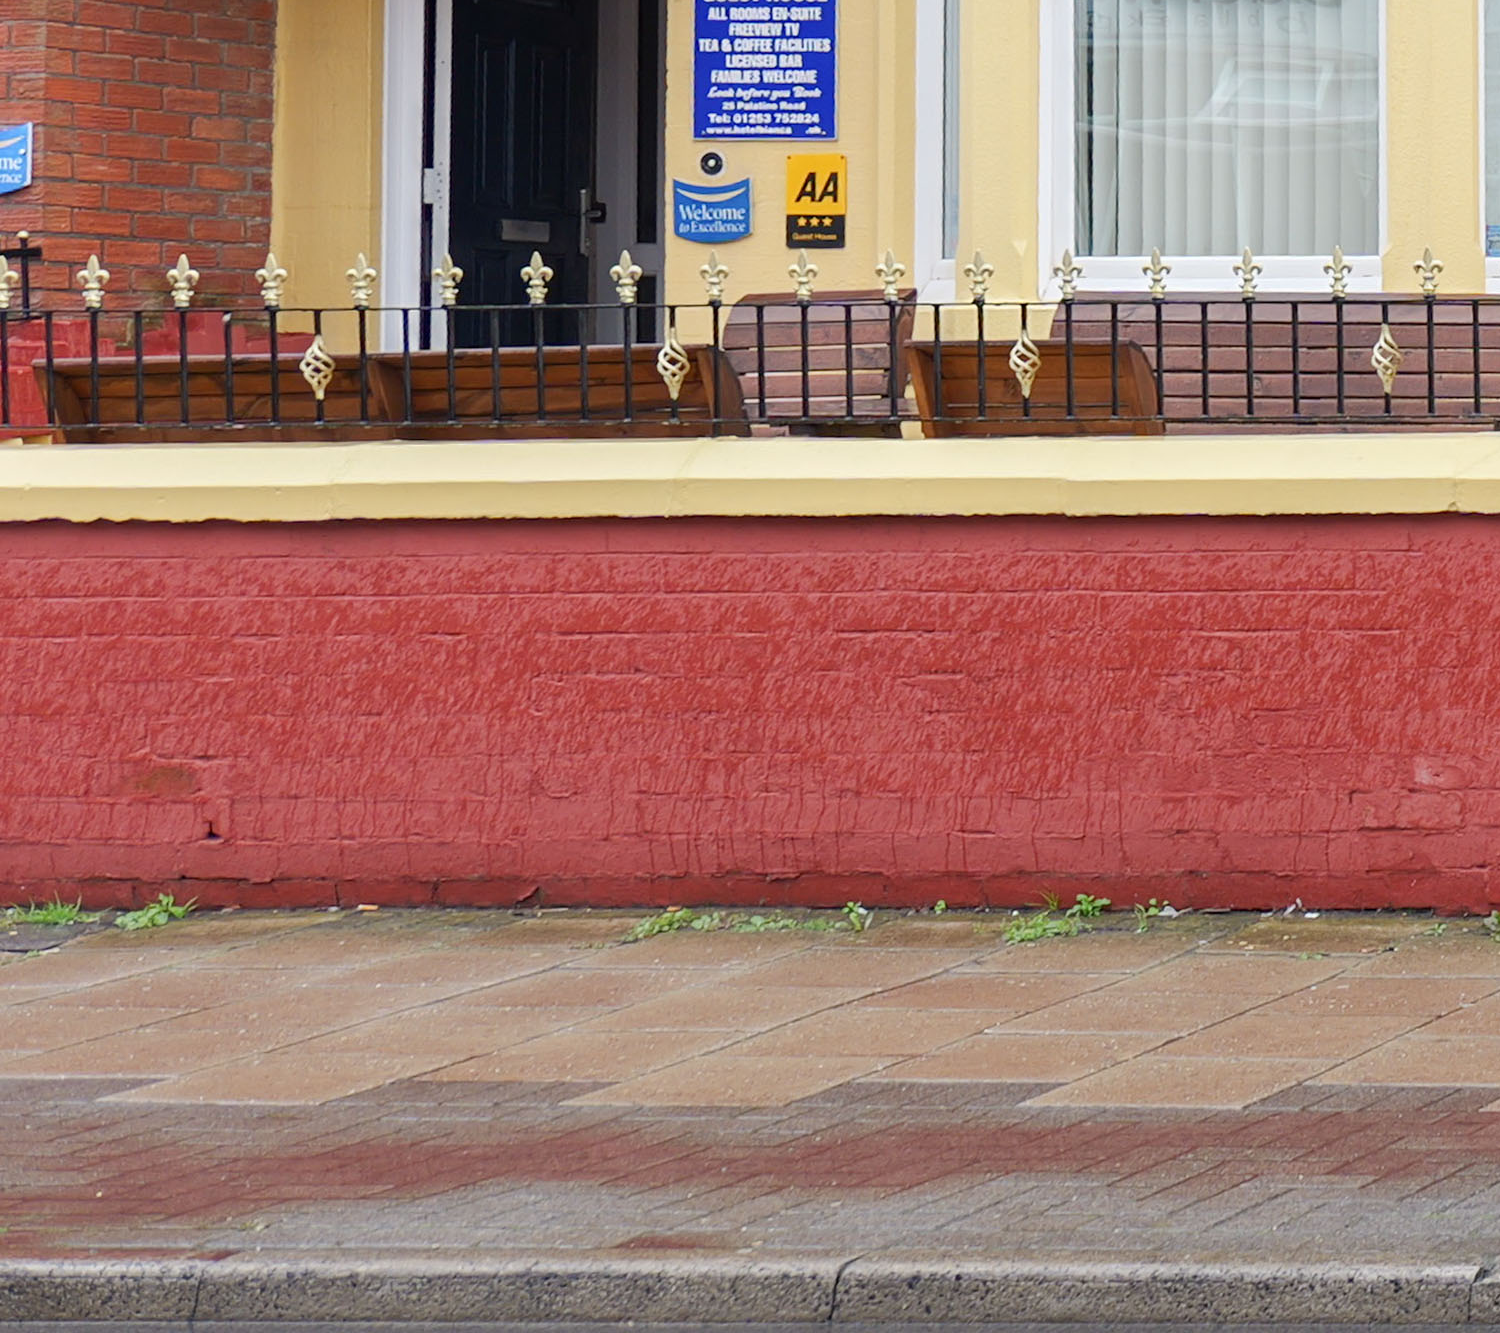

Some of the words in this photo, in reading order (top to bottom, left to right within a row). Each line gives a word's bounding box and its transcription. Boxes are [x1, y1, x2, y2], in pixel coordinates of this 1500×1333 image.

[707, 7, 729, 21] ALL
[729, 7, 771, 21] ROOMS
[772, 7, 822, 21] EN-SUITE
[728, 22, 783, 37] FREEVIEW
[783, 23, 800, 36] TV
[698, 38, 719, 52] TEA
[720, 38, 732, 52] &
[733, 38, 773, 52] COFFEE
[774, 38, 832, 53] FACILITIES
[725, 54, 777, 68] LICENSED
[778, 54, 803, 68] BAR
[710, 69, 761, 83] FAMILIES
[762, 69, 818, 83] WELCOME
[732, 113, 772, 124] 01253
[773, 113, 820, 124] 752824
[794, 171, 839, 204] AA
[678, 203, 746, 221] Welcome
[678, 222, 690, 233] to
[691, 220, 746, 234] Excellence
